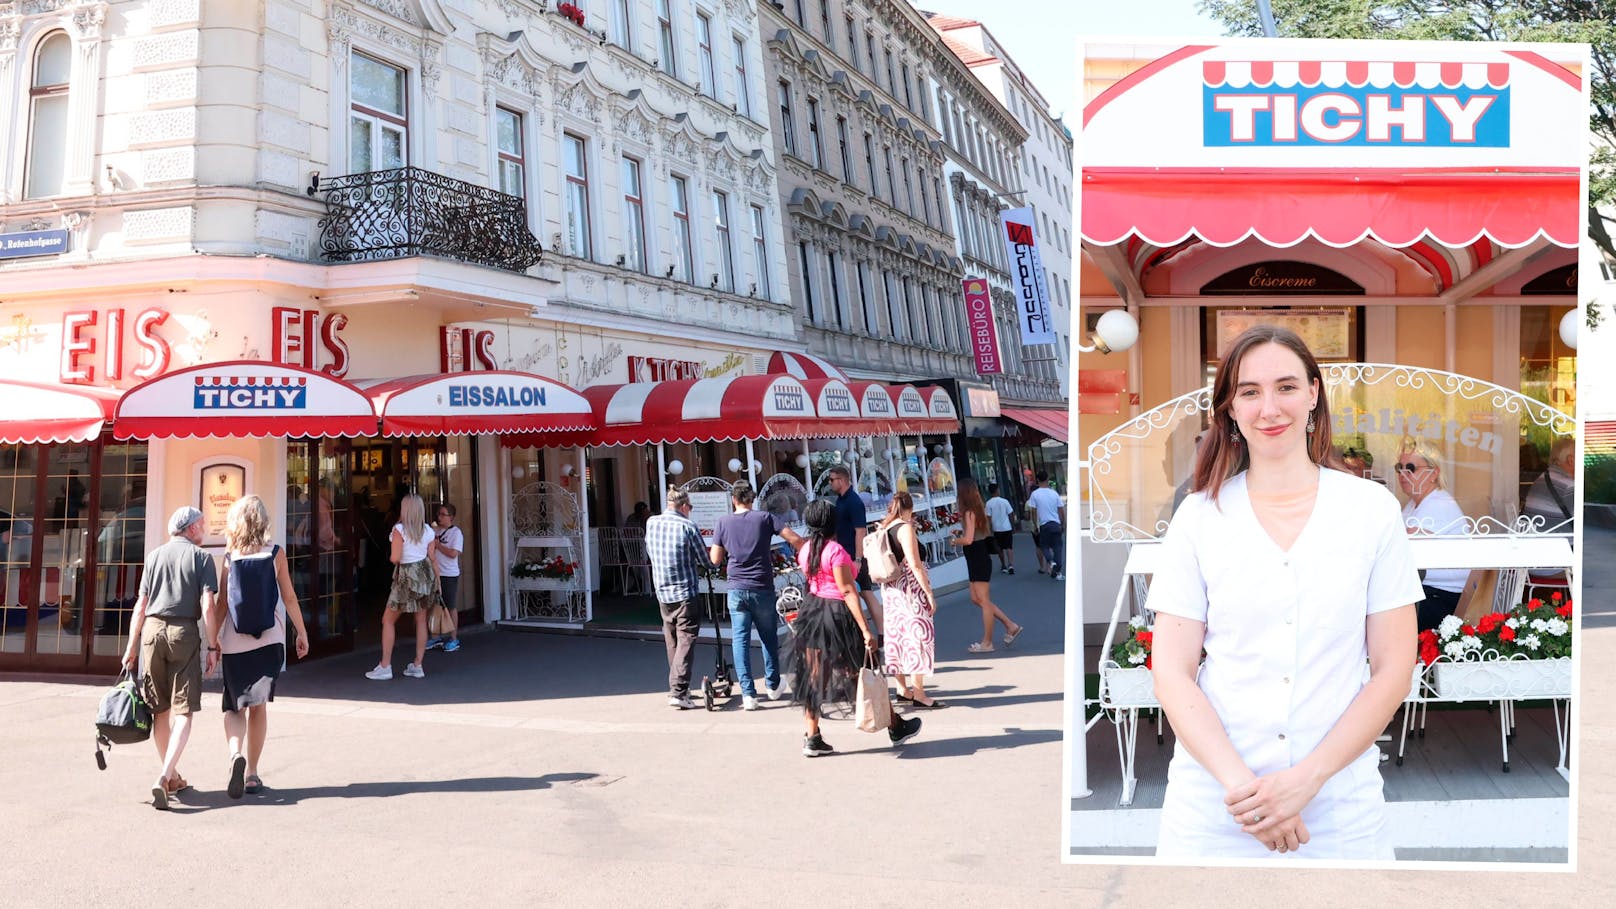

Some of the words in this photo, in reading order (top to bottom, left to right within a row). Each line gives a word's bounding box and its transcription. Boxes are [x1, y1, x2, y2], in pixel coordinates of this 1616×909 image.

[1213, 92, 1499, 143] TICHY
[1249, 266, 1317, 288] Eiscreme
[60, 306, 171, 384] EIS
[272, 306, 350, 380] EIS
[972, 299, 995, 371] REISEBÜRO
[439, 326, 499, 373] EIS
[627, 355, 645, 384] K
[646, 357, 704, 382] TICHY
[198, 388, 302, 409] TICHY
[448, 385, 547, 408] EISSALON
[775, 394, 802, 410] TICHY
[827, 397, 849, 410] TICHY
[868, 399, 889, 411] TICHY
